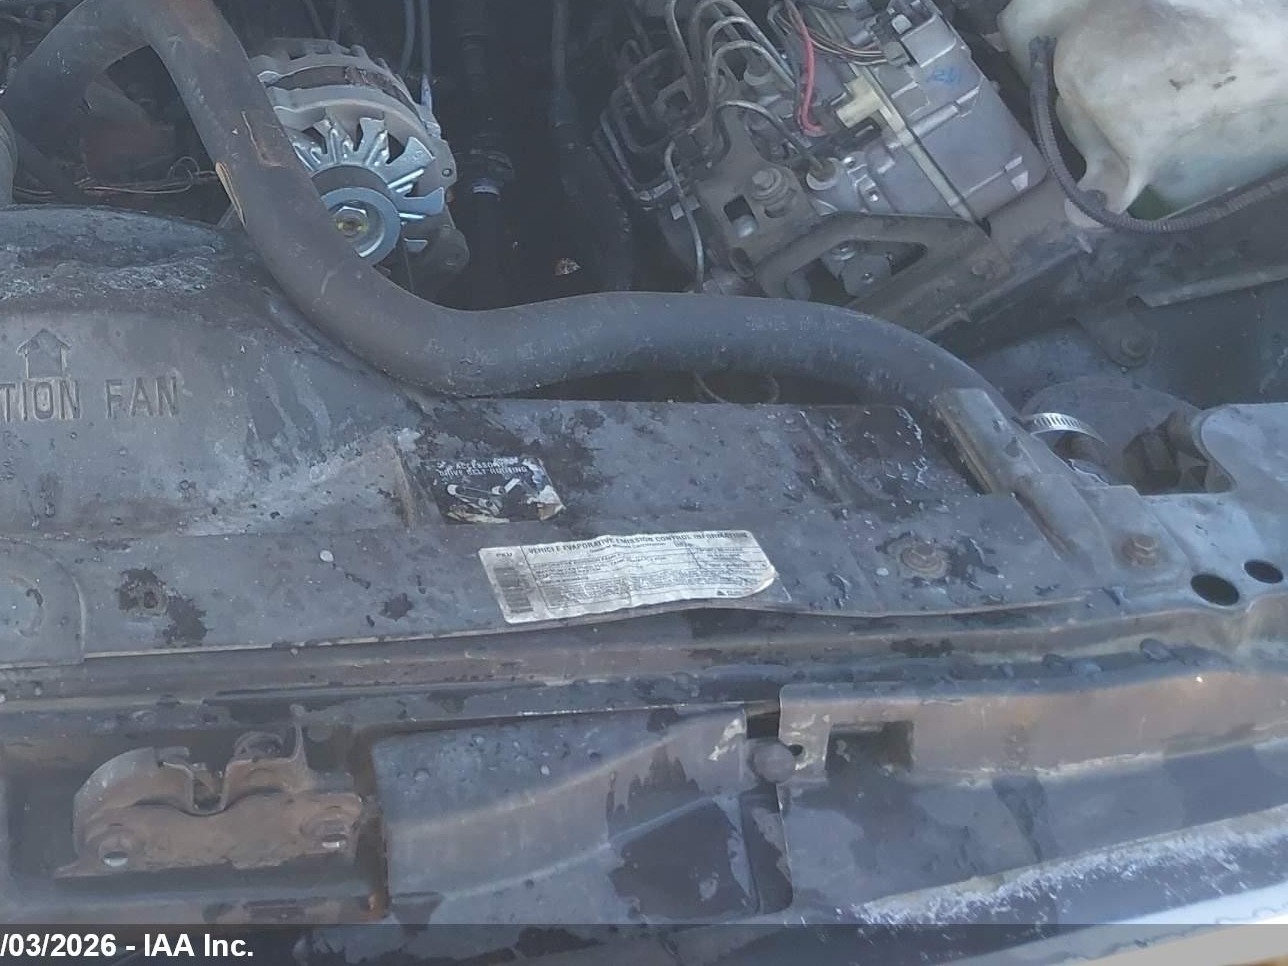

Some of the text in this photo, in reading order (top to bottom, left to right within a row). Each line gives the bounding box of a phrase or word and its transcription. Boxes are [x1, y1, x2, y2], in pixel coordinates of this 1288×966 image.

[104, 375, 178, 418] FAN
[562, 537, 614, 550] EVAPORATIVE
[655, 534, 690, 543] CONTROL
